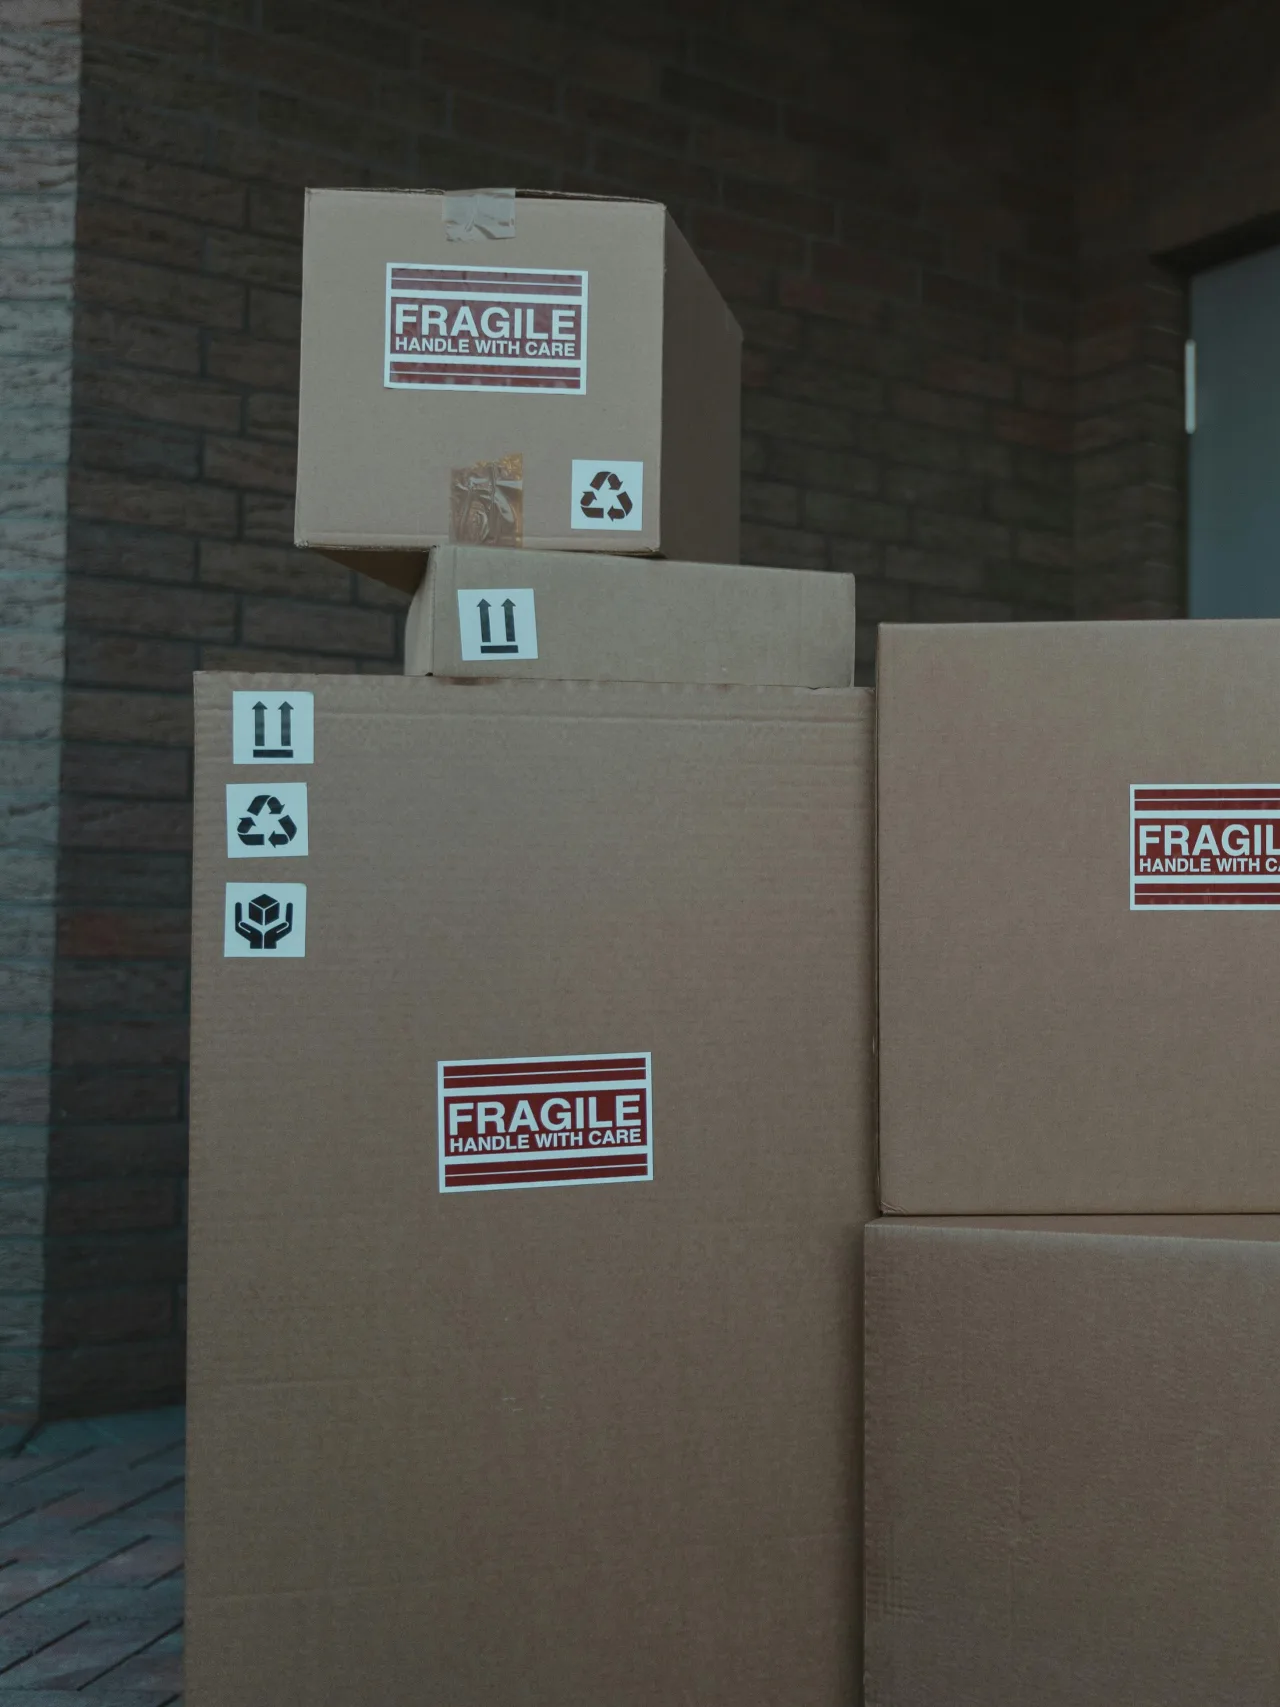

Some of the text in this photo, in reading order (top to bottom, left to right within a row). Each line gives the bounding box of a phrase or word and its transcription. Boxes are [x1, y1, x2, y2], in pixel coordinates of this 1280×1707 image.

[395, 303, 576, 341] FRAGILE
[395, 337, 576, 357] HANDLE WITH CARE
[1139, 858, 1211, 873] HANDLE
[1215, 858, 1260, 872] WITH
[449, 1094, 642, 1136] FRAGILE
[450, 1128, 642, 1153] HANDLE WITH CARE
